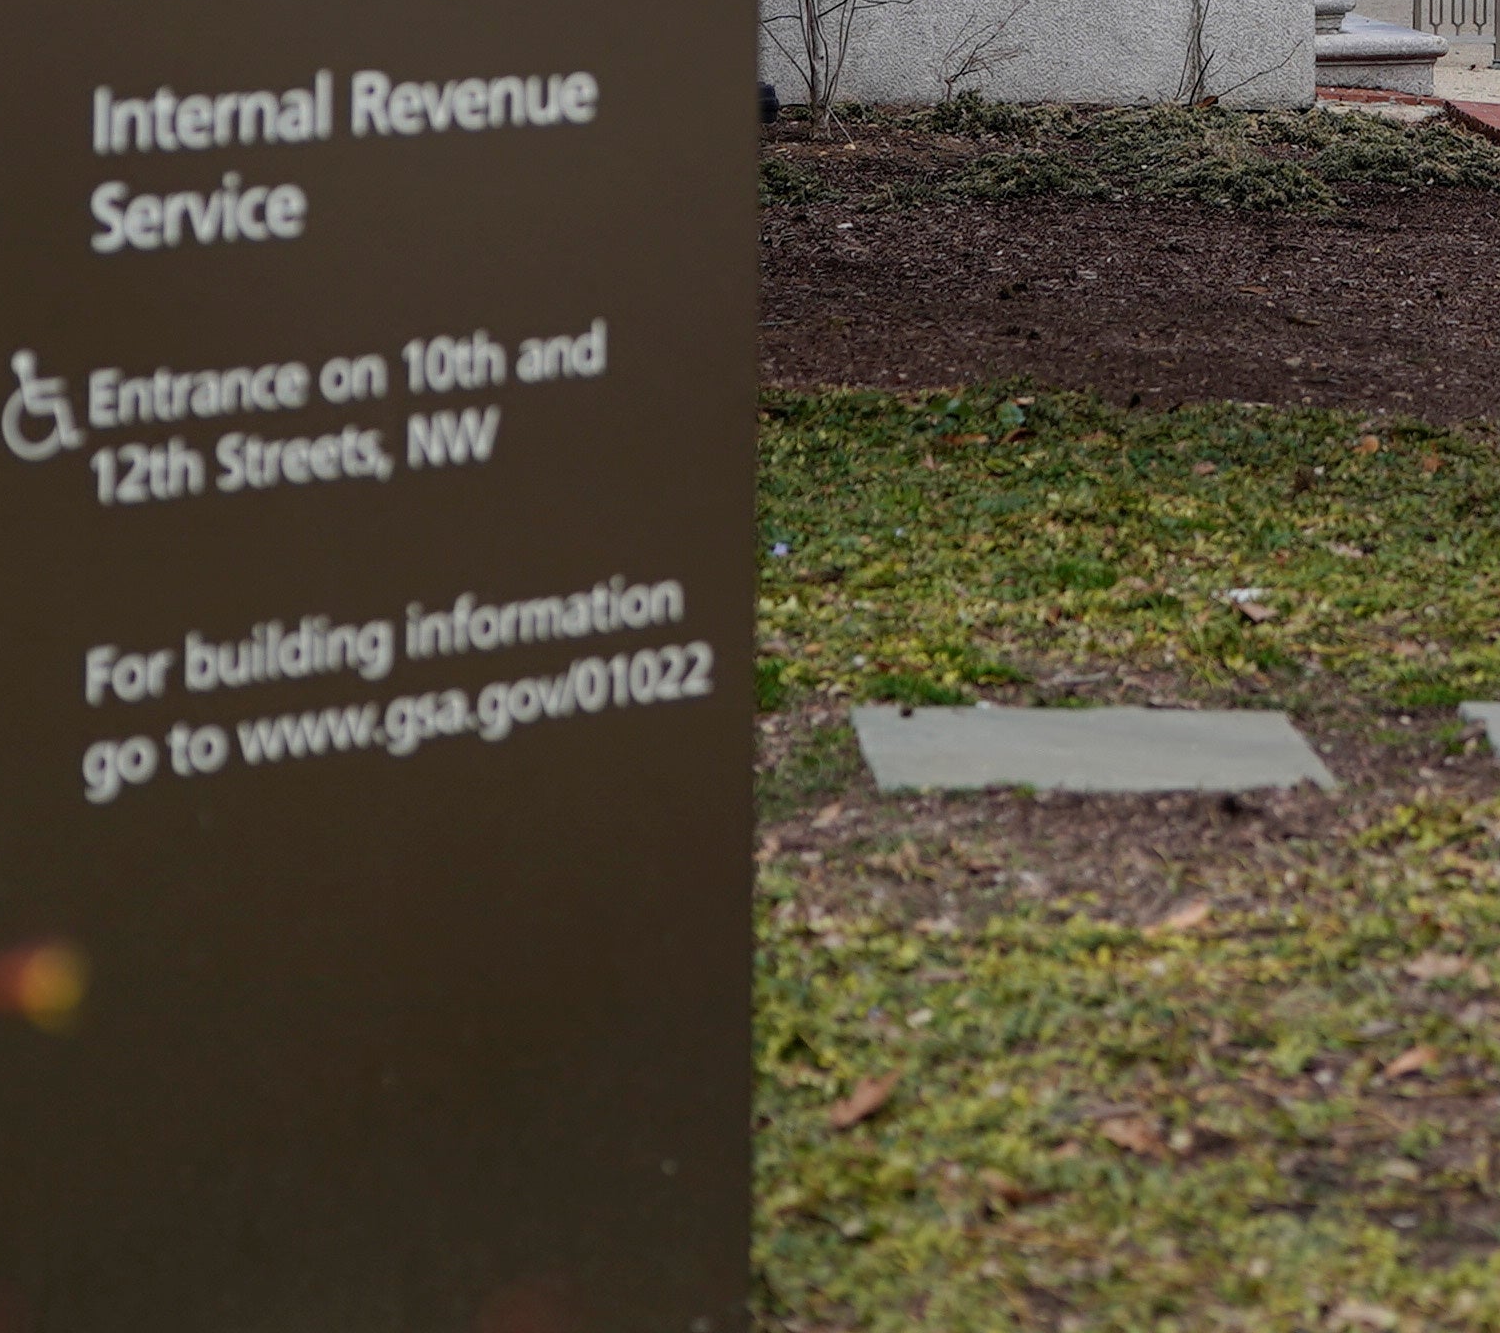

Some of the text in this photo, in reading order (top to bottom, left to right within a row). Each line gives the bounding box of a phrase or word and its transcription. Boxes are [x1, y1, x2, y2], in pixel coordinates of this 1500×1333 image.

[93, 67, 599, 155] Internal Revenue
[90, 170, 308, 254] Service
[88, 316, 608, 428] Entrance on 10th and
[90, 405, 501, 506] 12th Streets, NW
[85, 574, 686, 708] For building information
[82, 640, 713, 806] go to www.gsa.gov/01022
